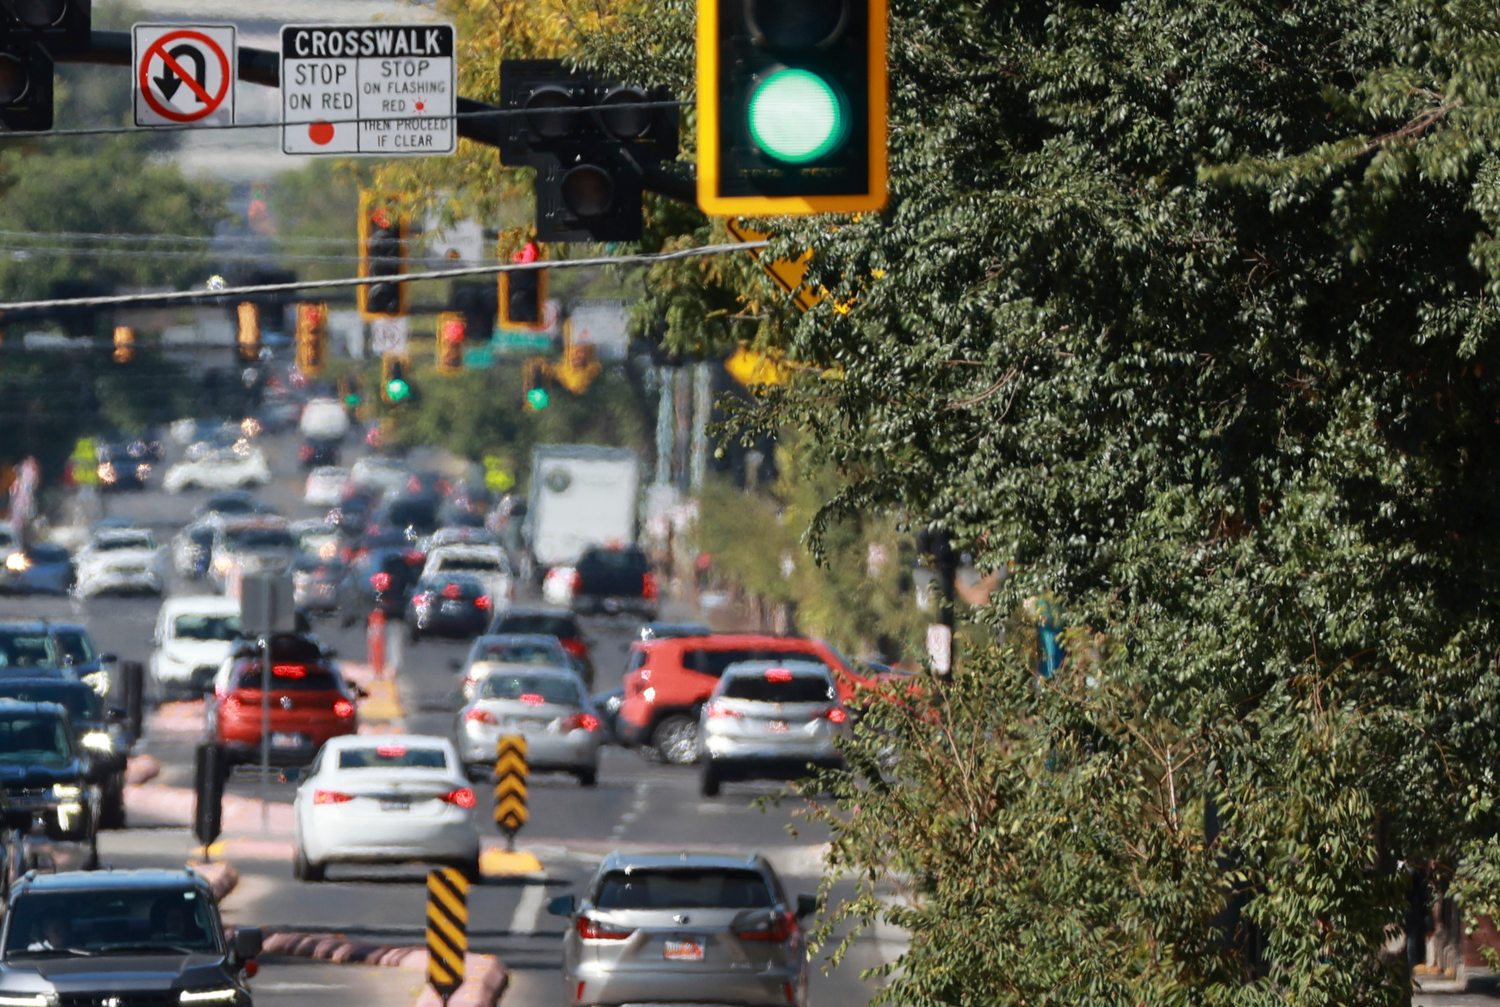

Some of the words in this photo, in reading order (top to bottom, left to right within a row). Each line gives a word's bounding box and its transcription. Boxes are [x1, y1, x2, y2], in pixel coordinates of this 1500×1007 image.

[295, 30, 441, 56] CROSSWALK
[295, 64, 347, 85] STOP
[381, 60, 430, 78] STOP
[363, 82, 381, 95] ON
[387, 81, 445, 94] FLASHING
[289, 94, 312, 111] ON
[322, 93, 353, 110] RED
[382, 99, 406, 112] RED
[364, 118, 390, 131] THEN
[396, 117, 448, 131] PROCEED
[377, 134, 388, 147] IF
[394, 134, 433, 147] CLEAR
